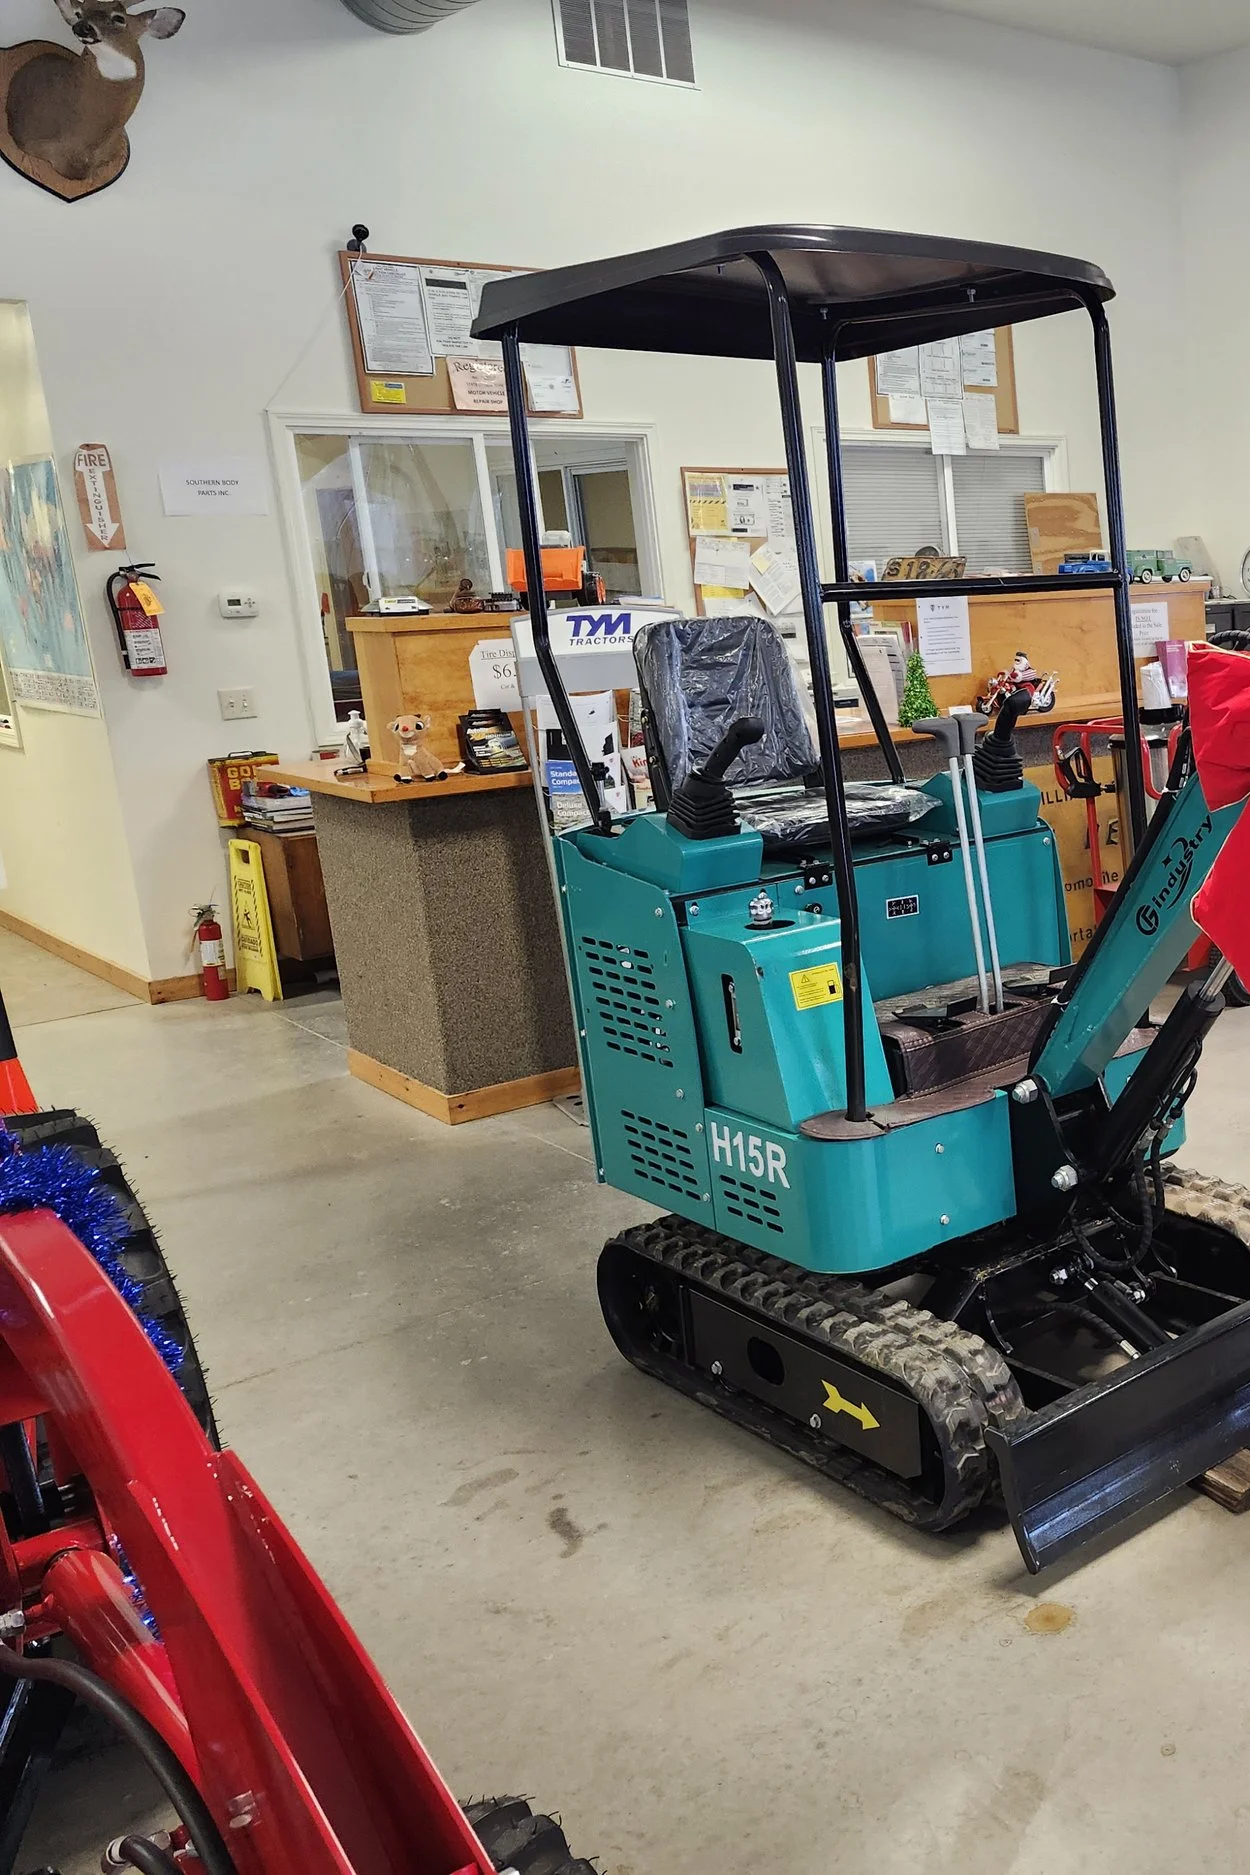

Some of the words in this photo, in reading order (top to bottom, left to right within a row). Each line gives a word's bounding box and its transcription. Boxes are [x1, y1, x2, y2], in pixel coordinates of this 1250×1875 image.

[77, 453, 107, 467] FIRE
[89, 468, 108, 541] EXTINGUISHER
[566, 613, 631, 637] TYM
[569, 635, 634, 646] TRACTORS
[480, 650, 497, 659] Tire
[492, 663, 516, 679] $6.
[632, 758, 648, 768] Kin
[1136, 815, 1213, 936] Gindustry
[710, 1122, 790, 1189] H15R
